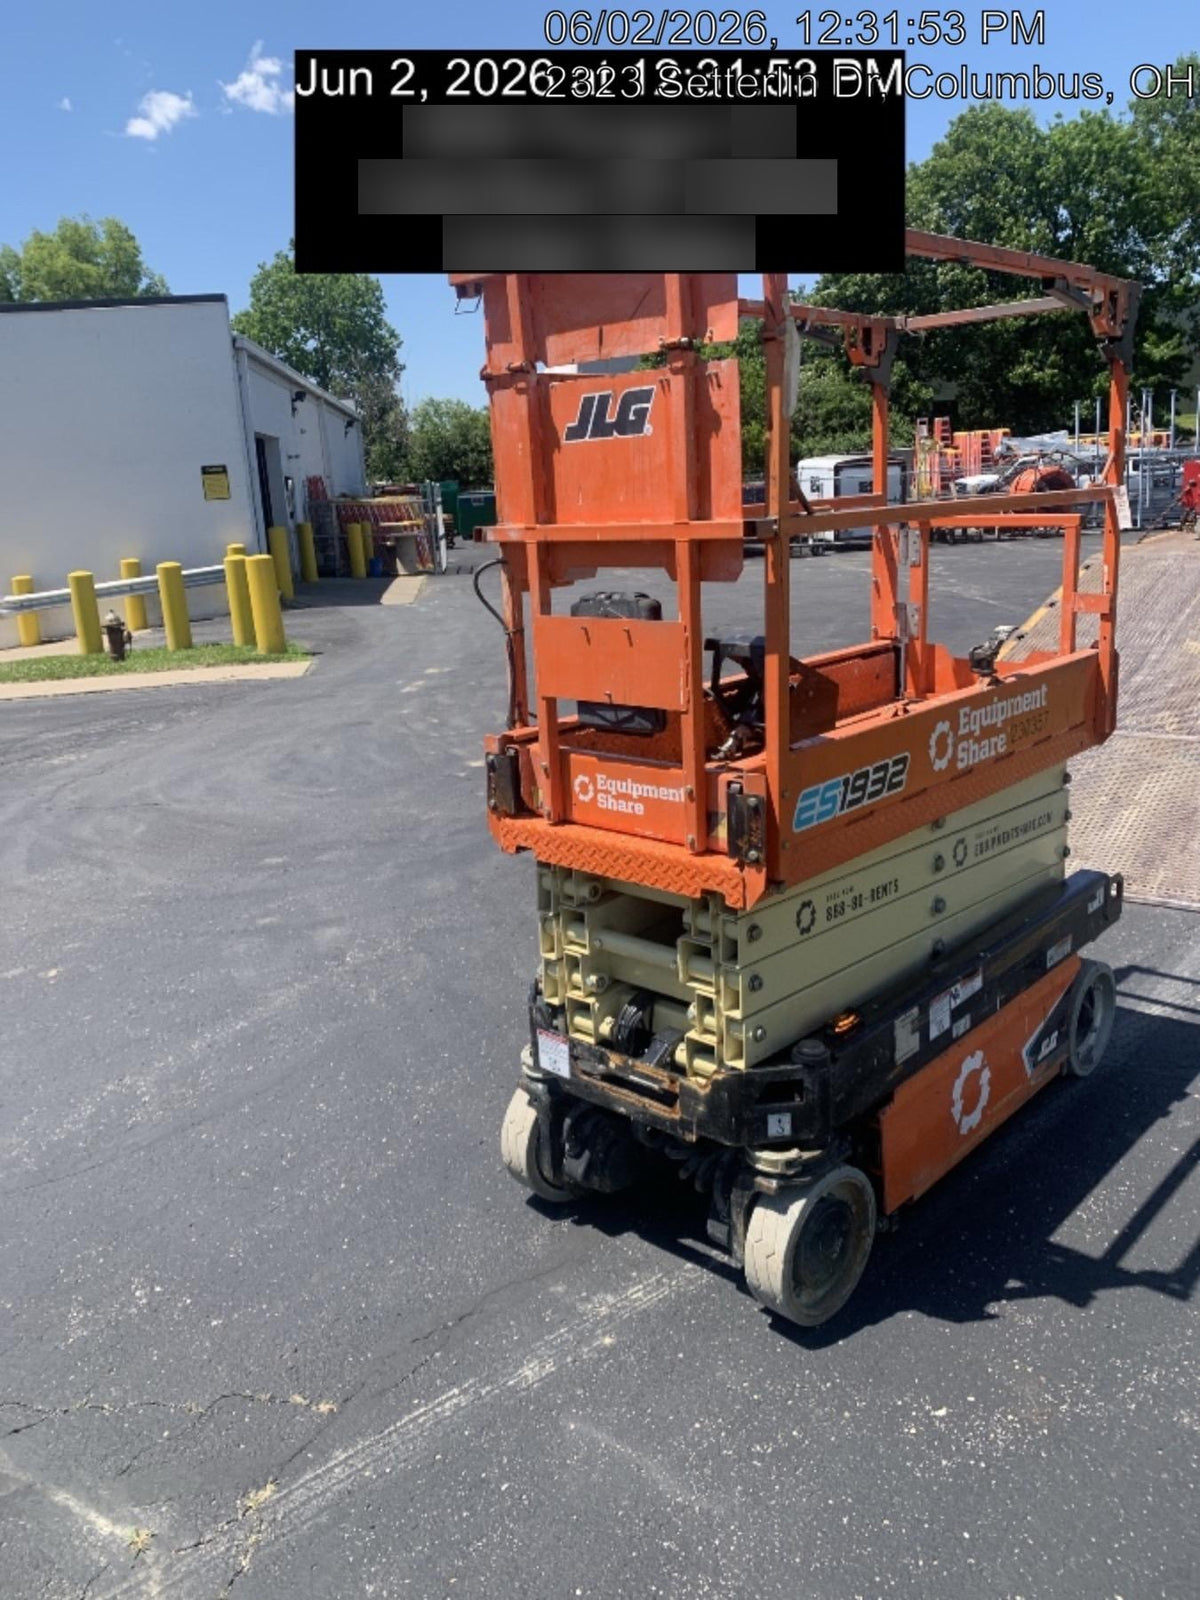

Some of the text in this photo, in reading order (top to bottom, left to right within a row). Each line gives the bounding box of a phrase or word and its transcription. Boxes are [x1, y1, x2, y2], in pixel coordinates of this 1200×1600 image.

[563, 384, 656, 443] JLG
[958, 682, 1048, 736] Equipment
[956, 732, 1007, 770] Share
[596, 773, 685, 803] Equipment
[596, 792, 645, 816] Share
[792, 752, 911, 833] ES1932
